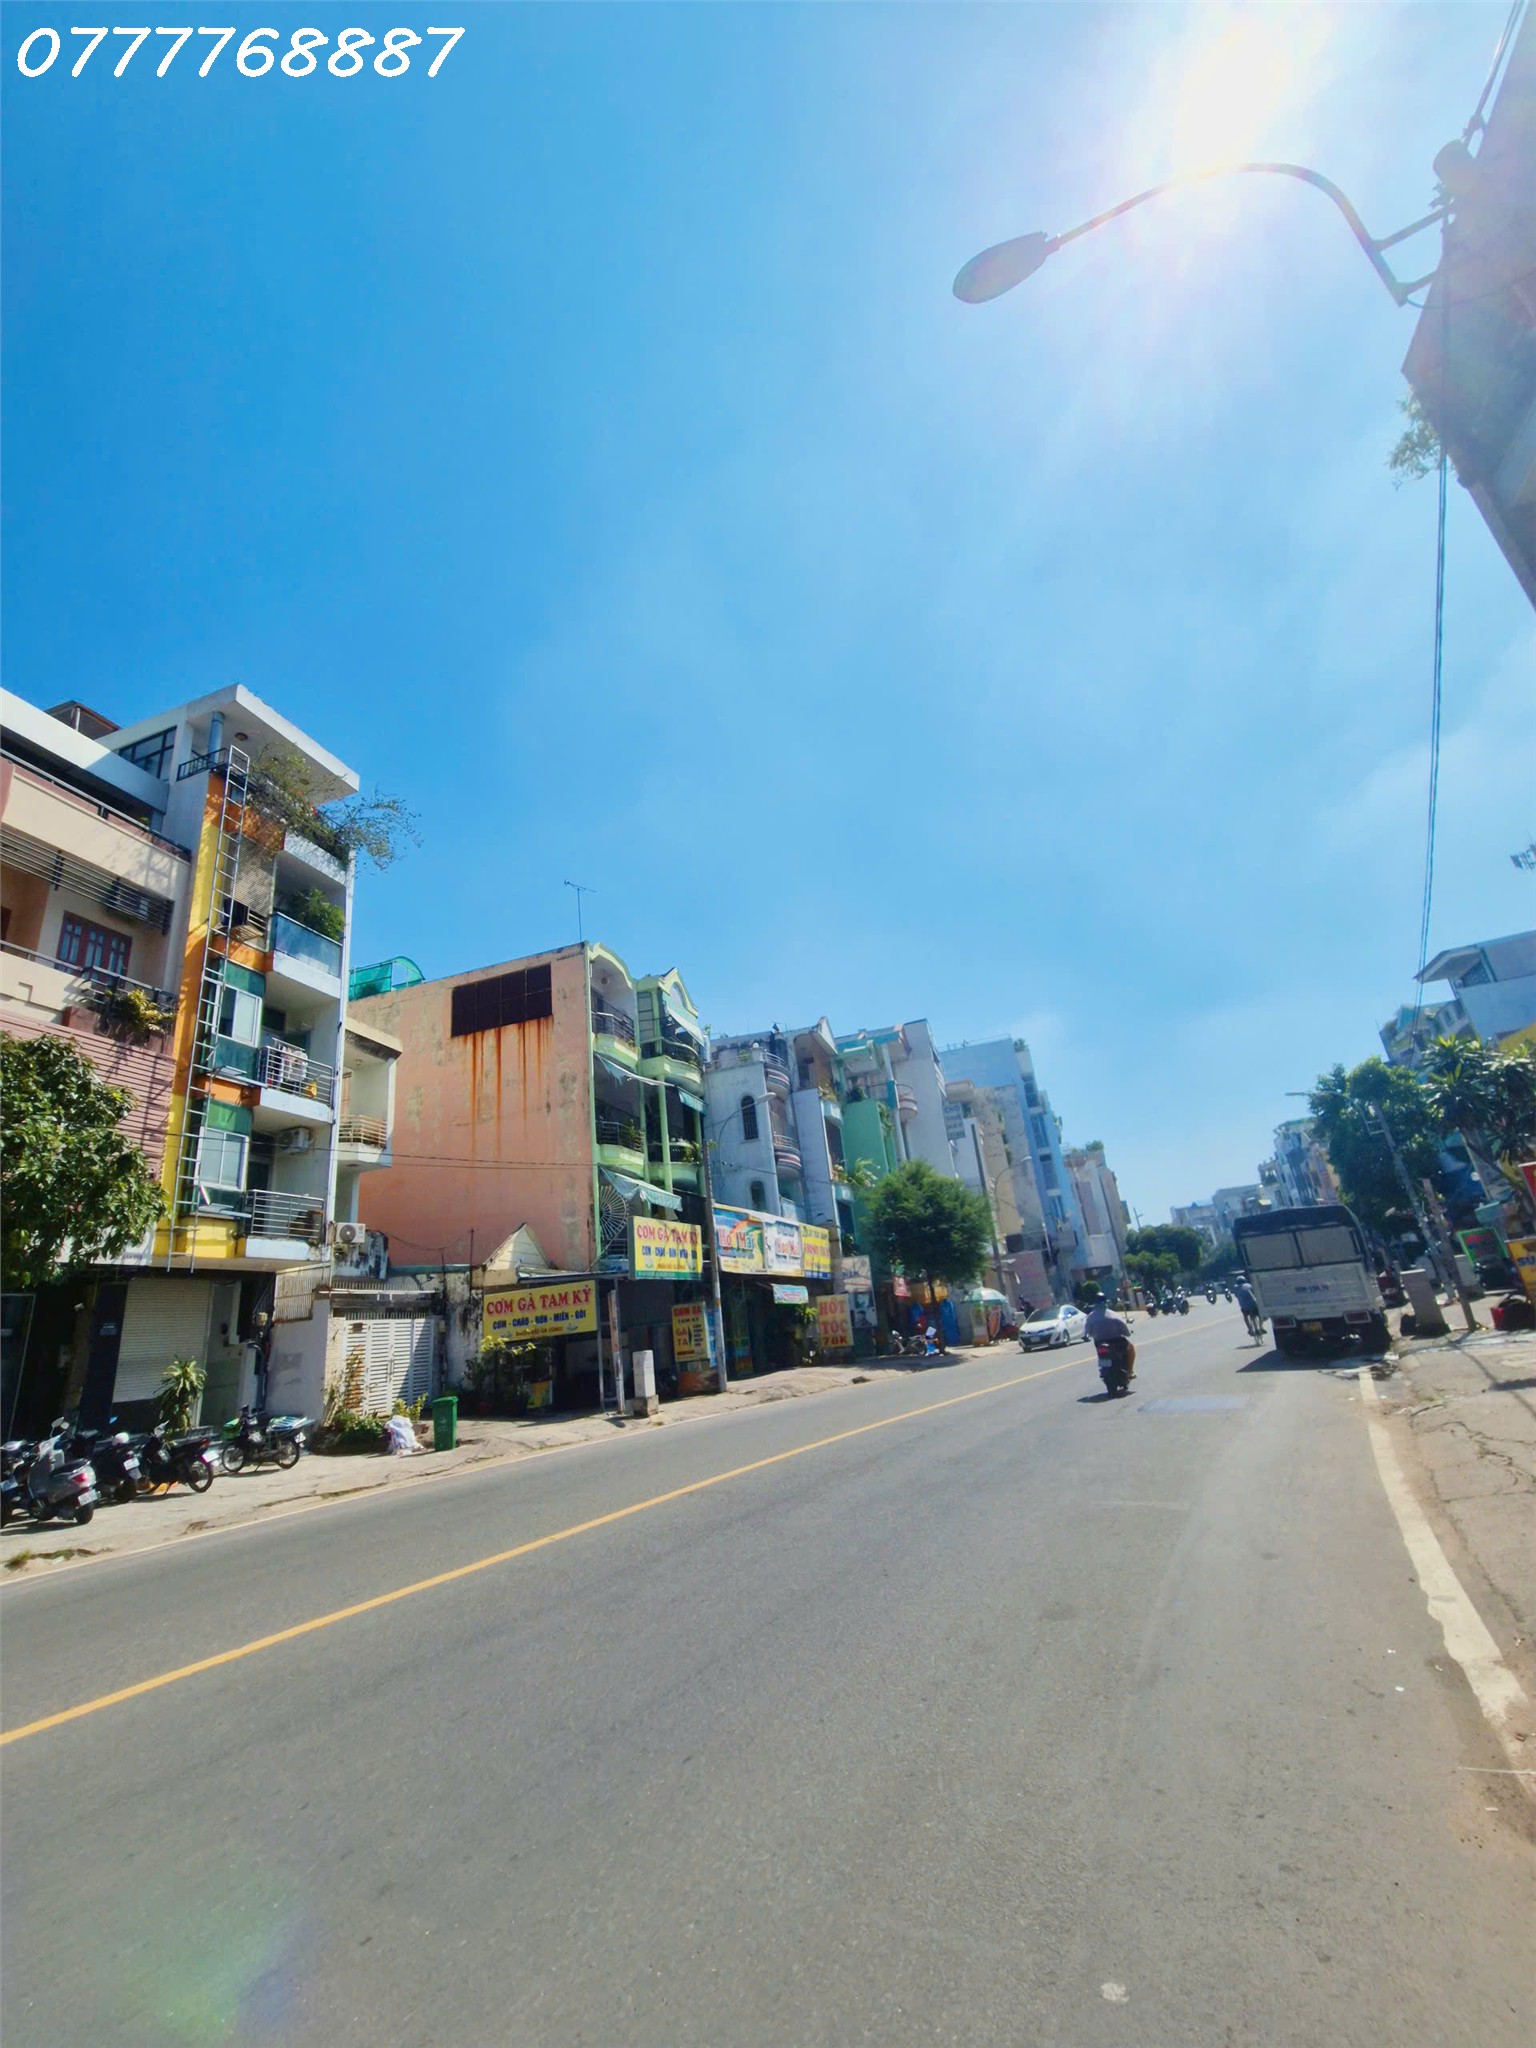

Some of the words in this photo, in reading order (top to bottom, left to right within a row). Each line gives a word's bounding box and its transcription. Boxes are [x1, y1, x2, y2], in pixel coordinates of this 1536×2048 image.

[486, 1298, 513, 1315] CƠM
[517, 1293, 536, 1311] GÀ
[540, 1292, 568, 1308] TAM
[573, 1285, 592, 1305] KỲ
[824, 1335, 848, 1345] 70K
